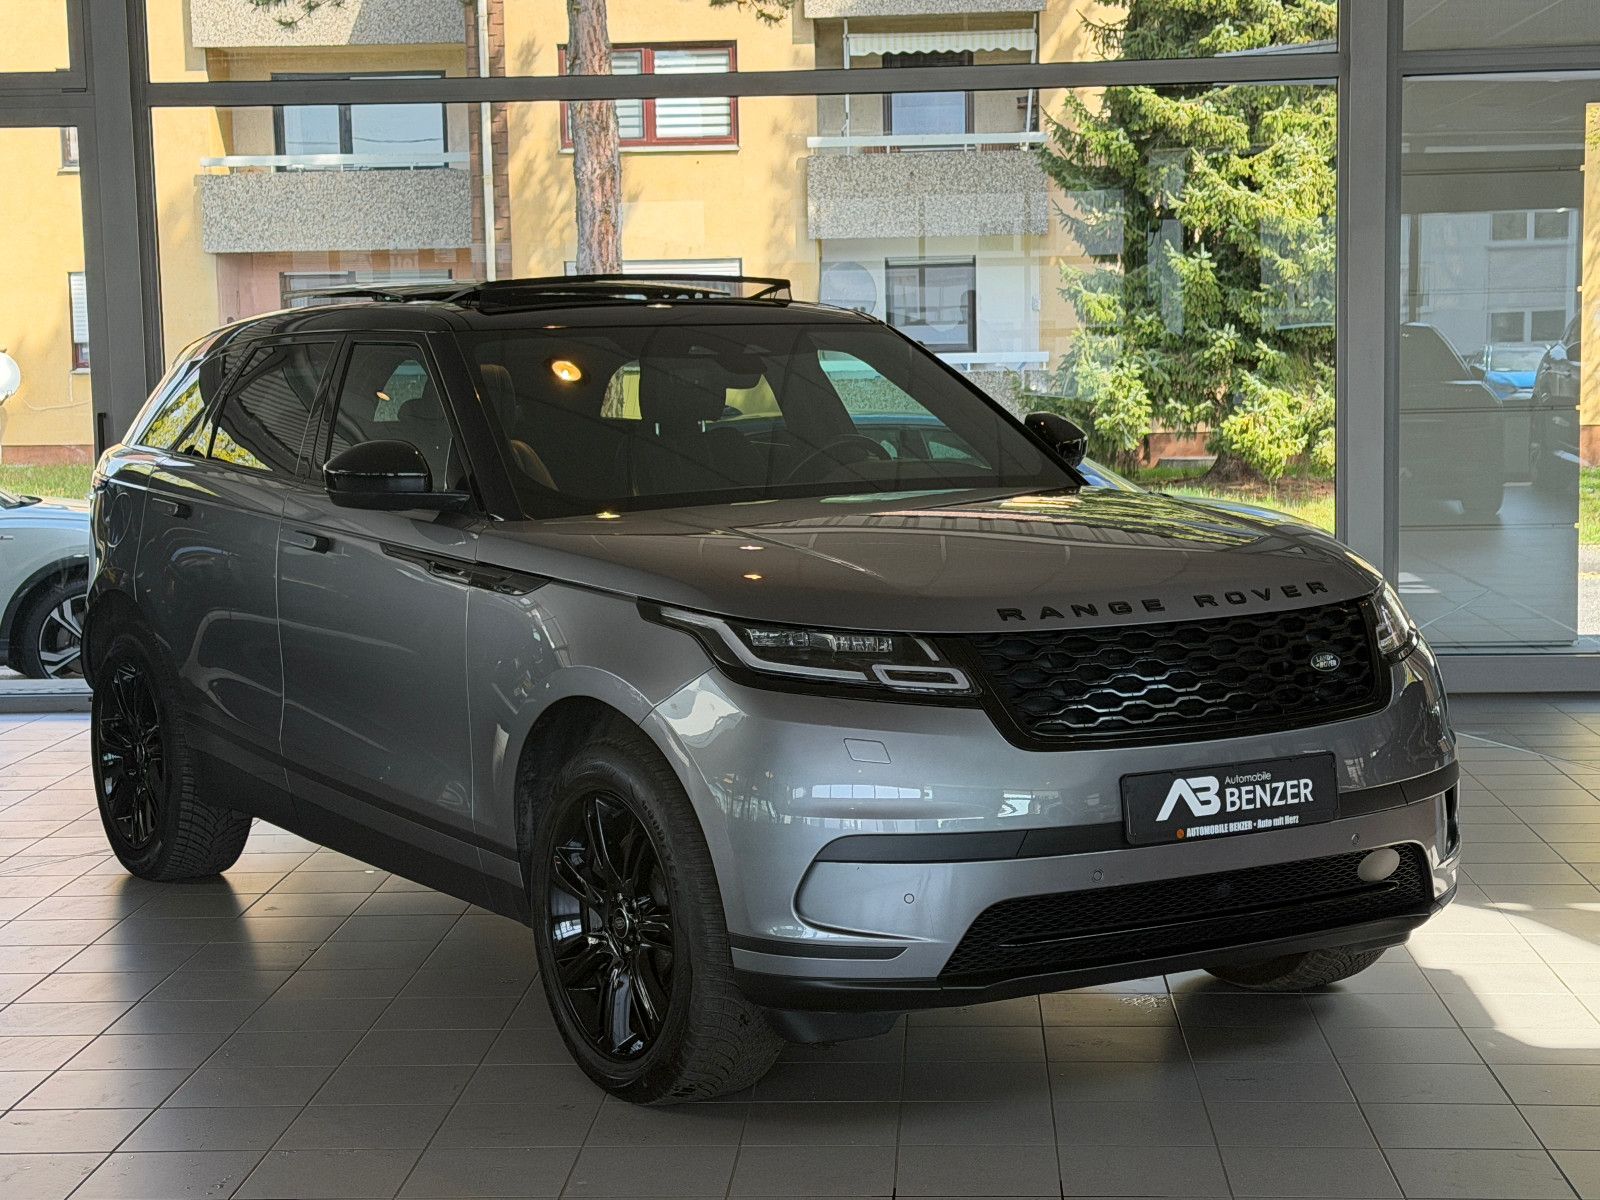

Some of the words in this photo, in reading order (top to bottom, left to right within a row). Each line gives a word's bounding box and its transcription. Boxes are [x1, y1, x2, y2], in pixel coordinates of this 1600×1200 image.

[996, 598, 1166, 622] RANGE
[1193, 580, 1329, 609] ROVER
[1224, 771, 1272, 785] Automobile
[1225, 778, 1314, 812] BENZER
[1155, 775, 1222, 822] AB
[1186, 822, 1229, 838] AUTOMOBILE
[1229, 820, 1253, 832] BENZER
[1257, 818, 1273, 829] Auto
[1273, 816, 1285, 826] mit
[1284, 815, 1299, 825] Herz
